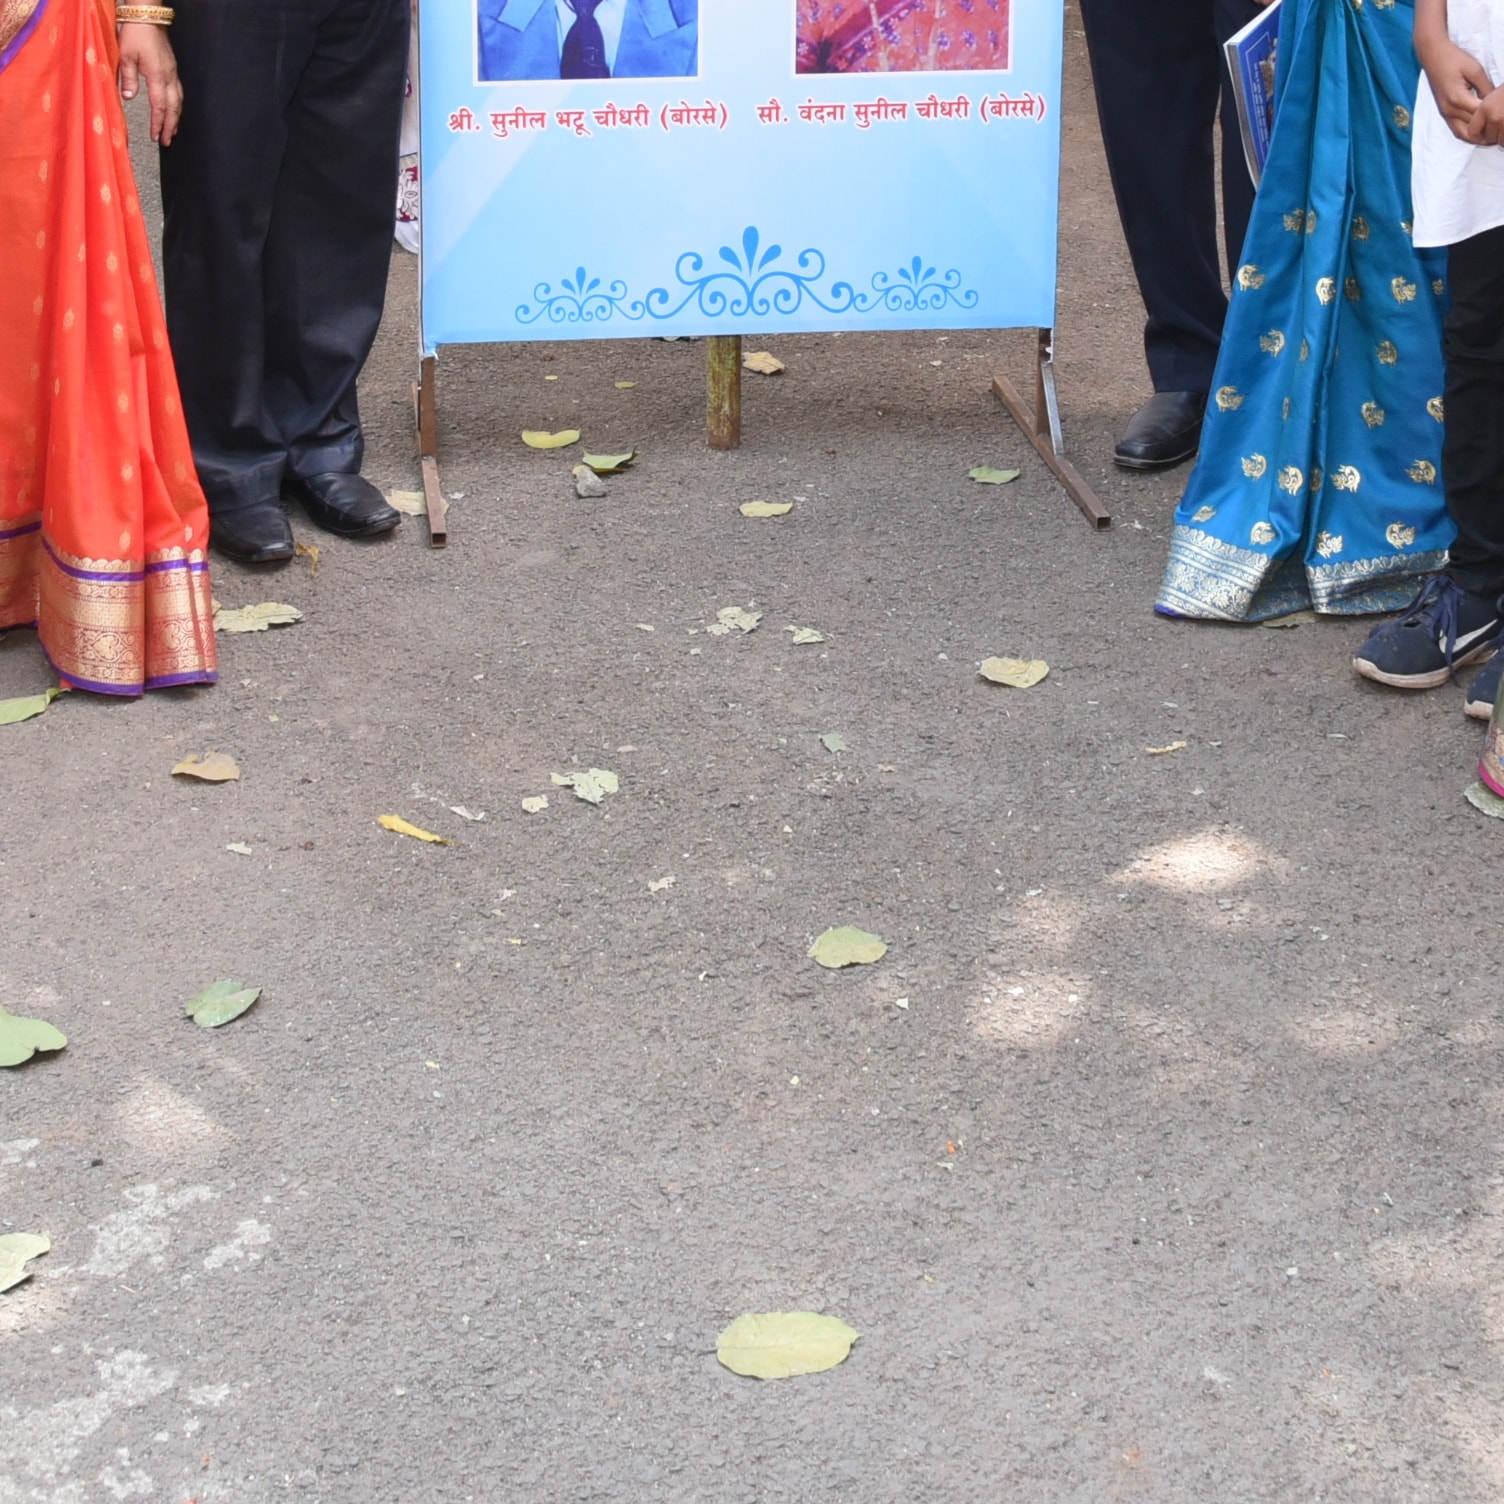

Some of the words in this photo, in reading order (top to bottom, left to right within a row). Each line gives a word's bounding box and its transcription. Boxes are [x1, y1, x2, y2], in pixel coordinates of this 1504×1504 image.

[449, 108, 481, 131] श्री.
[490, 106, 547, 137] सुनील
[593, 102, 650, 128] चौधरी
[660, 100, 728, 131] (बोरसे)
[757, 98, 788, 123] सौ.
[798, 98, 846, 124] वंदना
[853, 97, 907, 128] सुनील
[915, 94, 970, 119] चौधरी
[979, 92, 1046, 122] (बोरसे)
